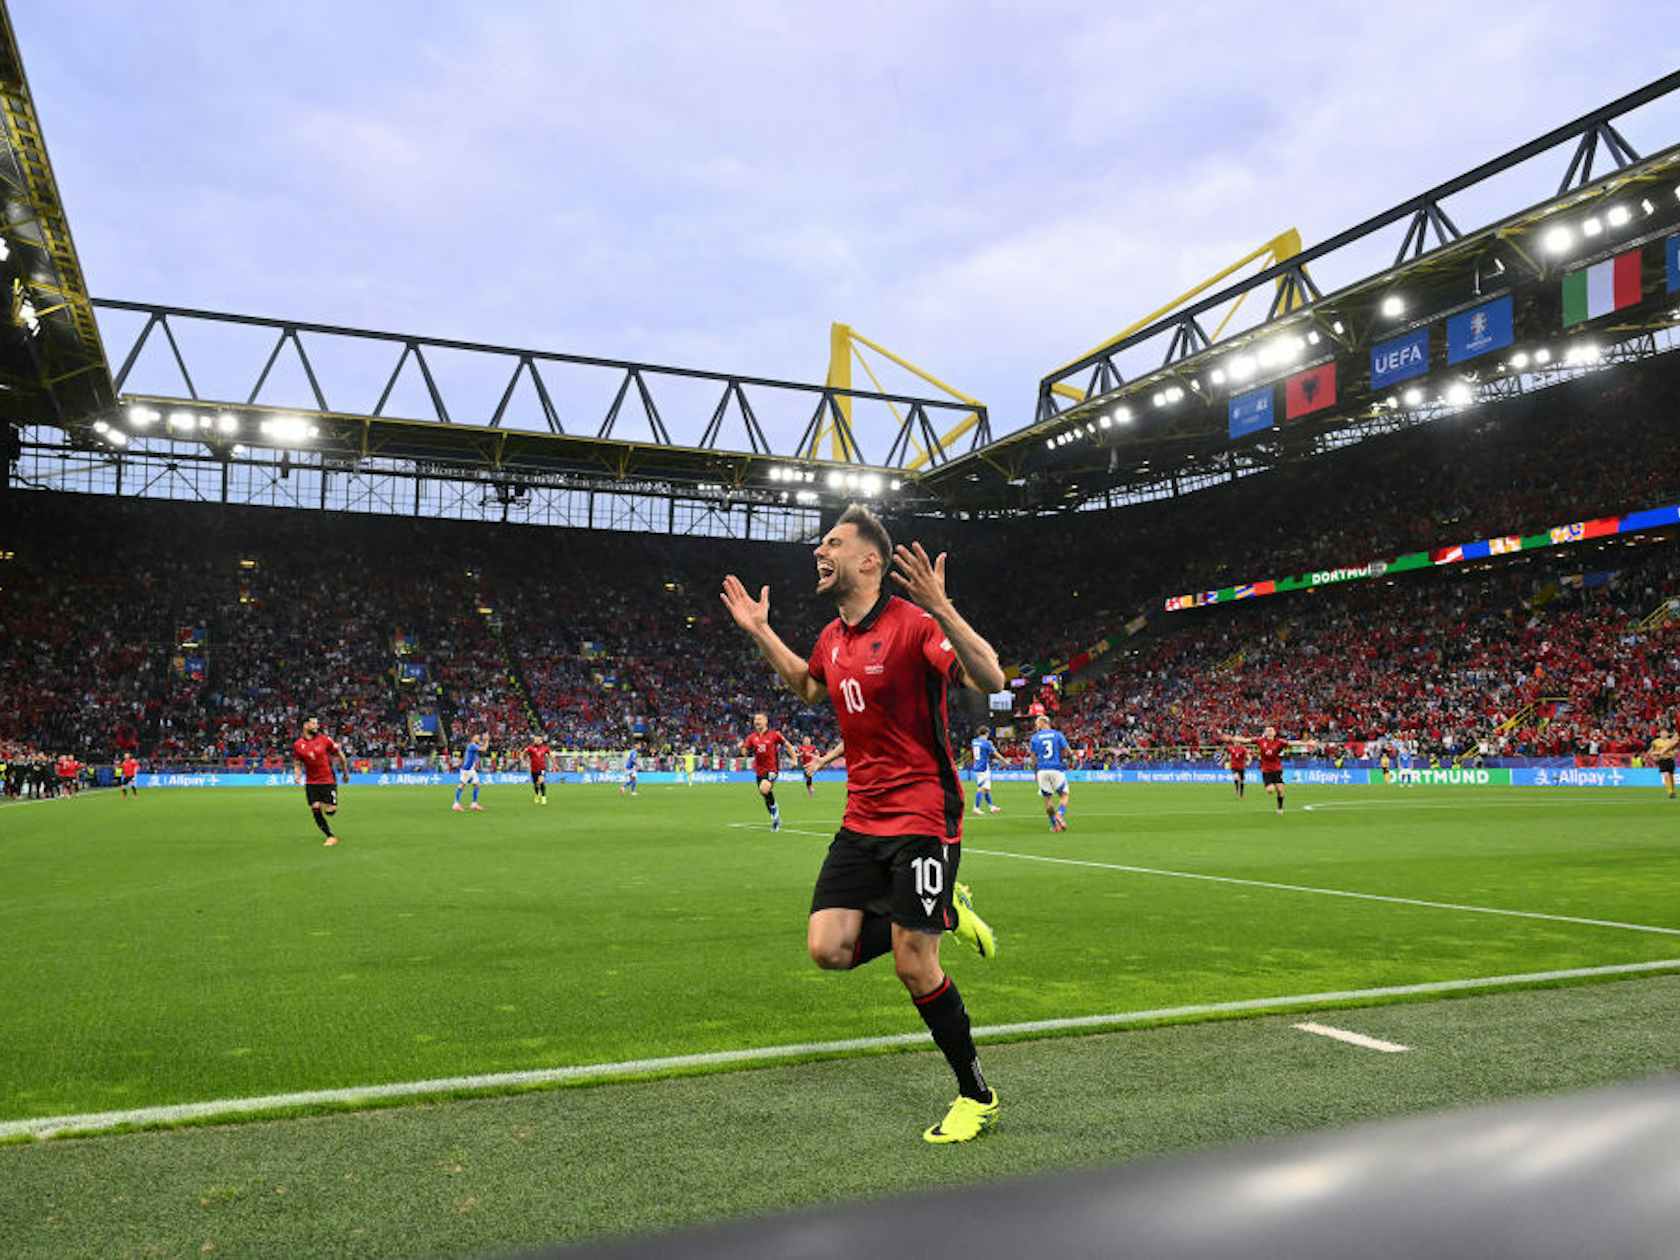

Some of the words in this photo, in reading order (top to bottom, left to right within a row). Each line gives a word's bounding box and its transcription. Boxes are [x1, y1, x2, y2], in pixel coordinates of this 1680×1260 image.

[1374, 345, 1422, 373] UEFA
[1312, 563, 1387, 585] DORTMU
[840, 678, 864, 713] 10
[1042, 740, 1053, 759] 3
[911, 857, 943, 895] 10
